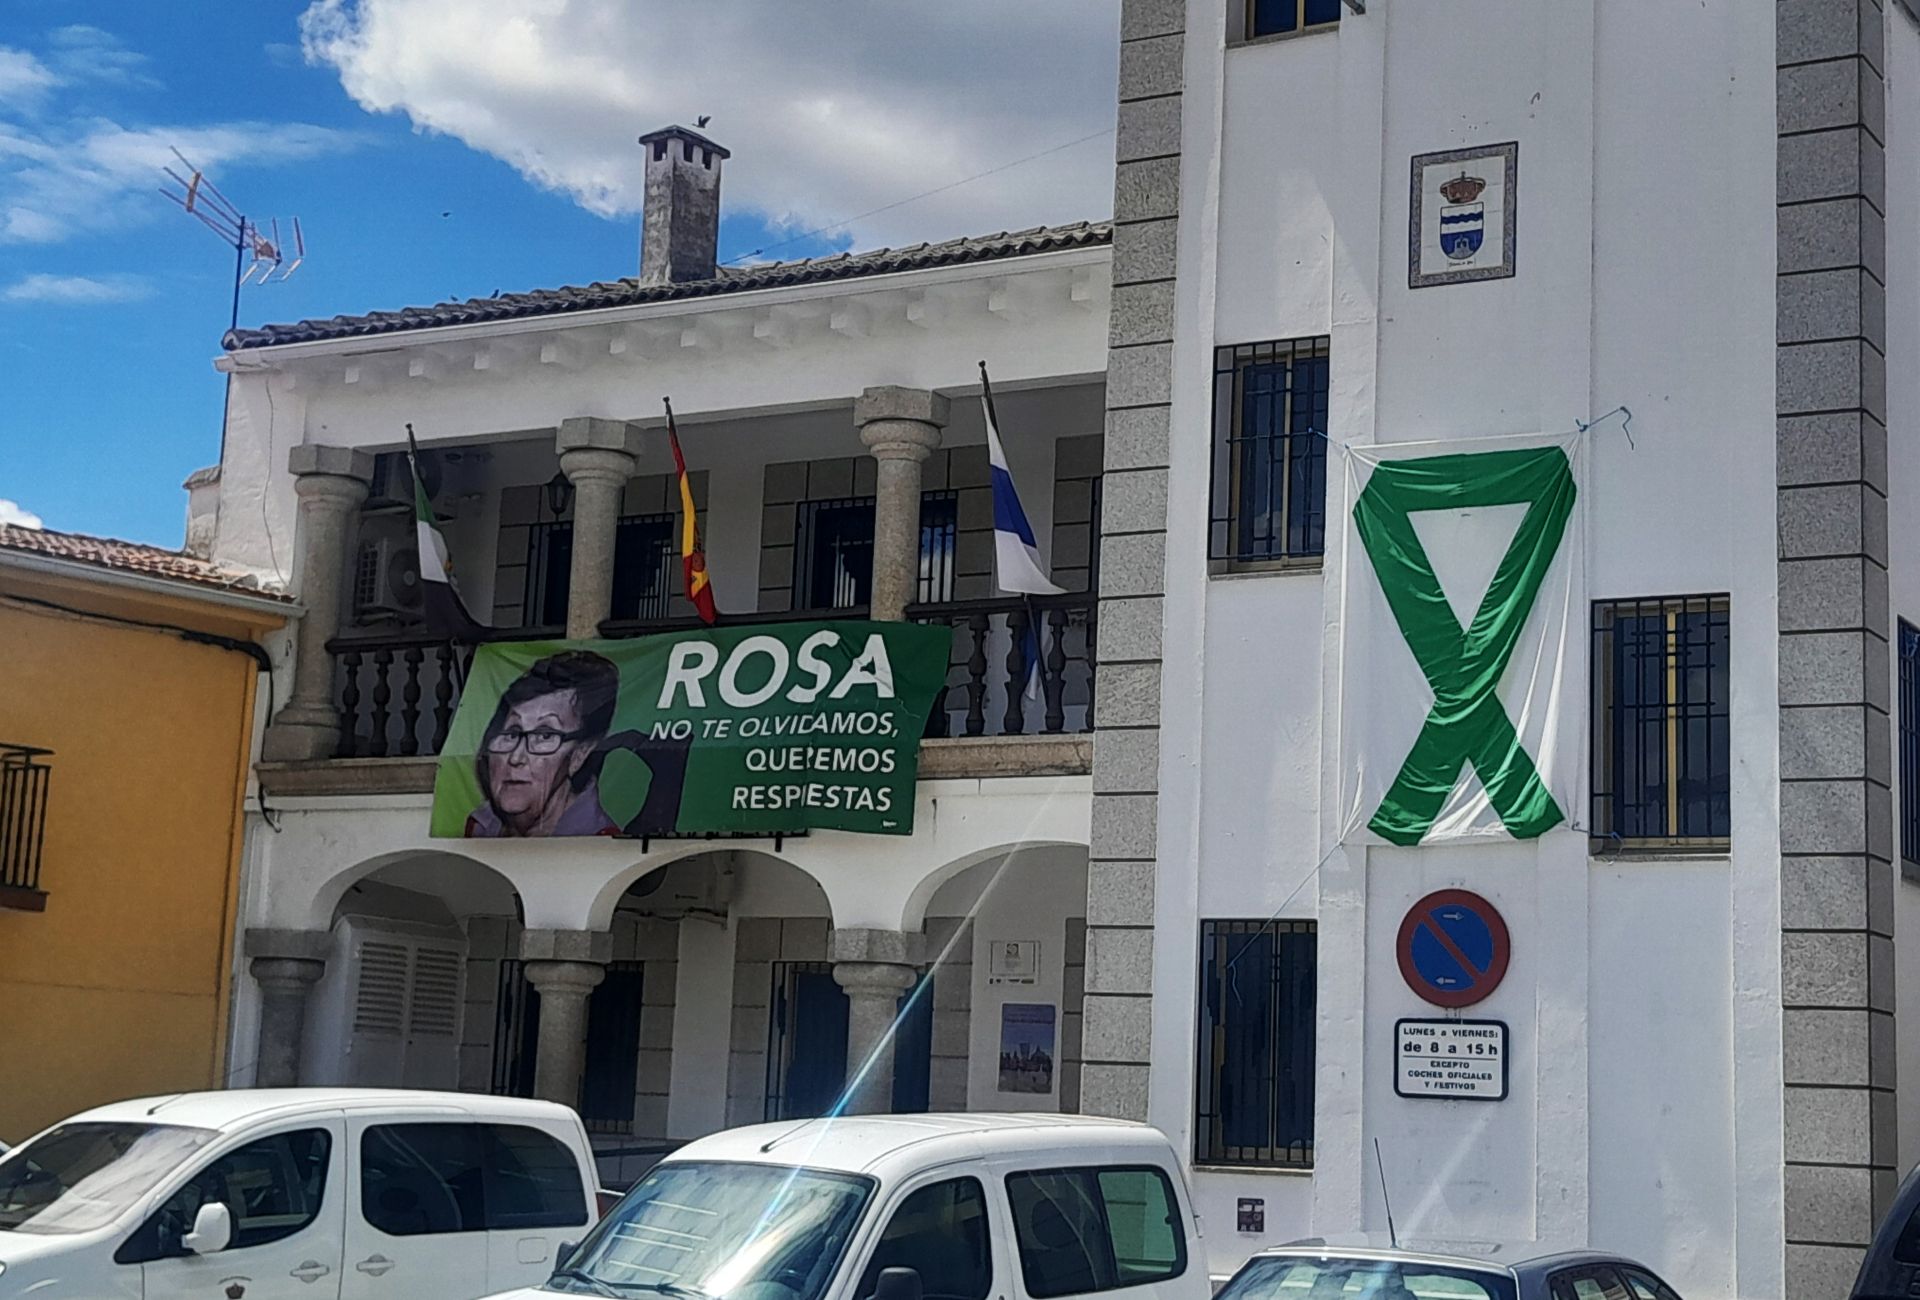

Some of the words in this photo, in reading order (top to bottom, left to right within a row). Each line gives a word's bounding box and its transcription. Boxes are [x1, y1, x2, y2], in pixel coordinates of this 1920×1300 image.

[656, 629, 895, 709] ROSA
[649, 719, 692, 741] NO
[702, 719, 733, 739] TE
[732, 783, 892, 812] RESPESTAS
[1403, 1027, 1436, 1036] LUNES
[1403, 1041, 1422, 1053] de
[1430, 1042, 1440, 1053] 8
[1448, 1044, 1457, 1054] a
[1430, 1060, 1470, 1069] EXCEPTO
[1408, 1070, 1443, 1079] COCHES
[1447, 1071, 1493, 1081] OFICIALES
[1433, 1081, 1476, 1090] FESTIVOS
